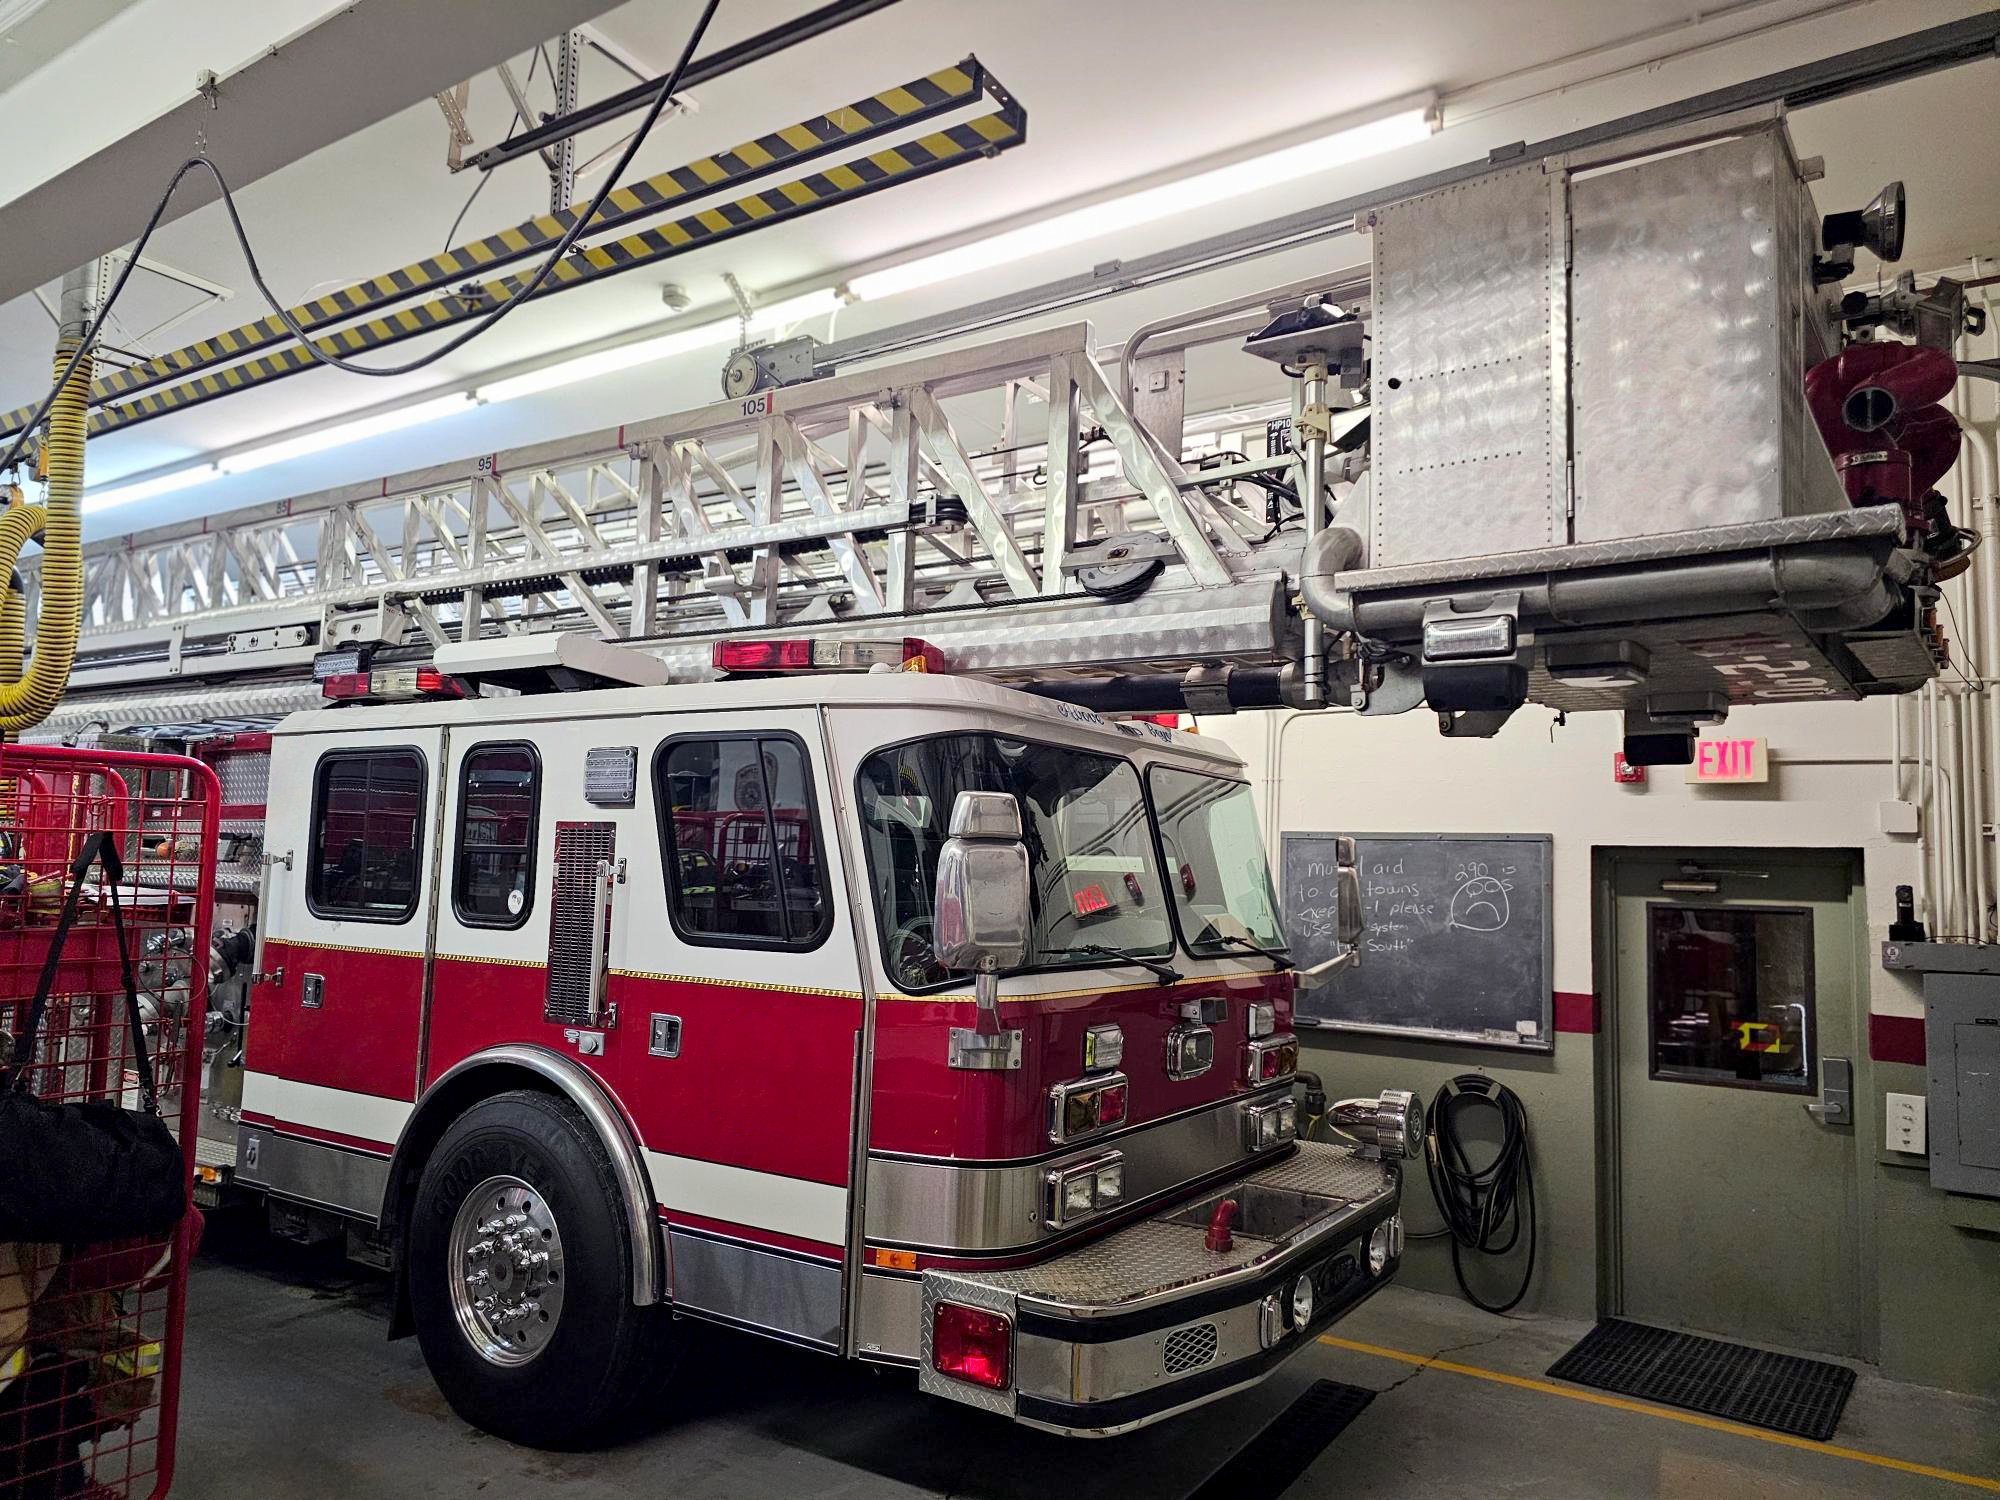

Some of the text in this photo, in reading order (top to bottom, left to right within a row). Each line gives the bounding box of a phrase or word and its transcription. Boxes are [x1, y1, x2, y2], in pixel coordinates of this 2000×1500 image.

[741, 397, 766, 416] 105
[1271, 418, 1291, 430] HP10
[478, 456, 492, 471] 95
[1698, 740, 1756, 779] EXIT
[1373, 858, 1404, 875] aid
[1455, 861, 1517, 881] 290 is
[1299, 883, 1319, 903] to
[1366, 880, 1420, 898] towns
[1389, 900, 1434, 916] please
